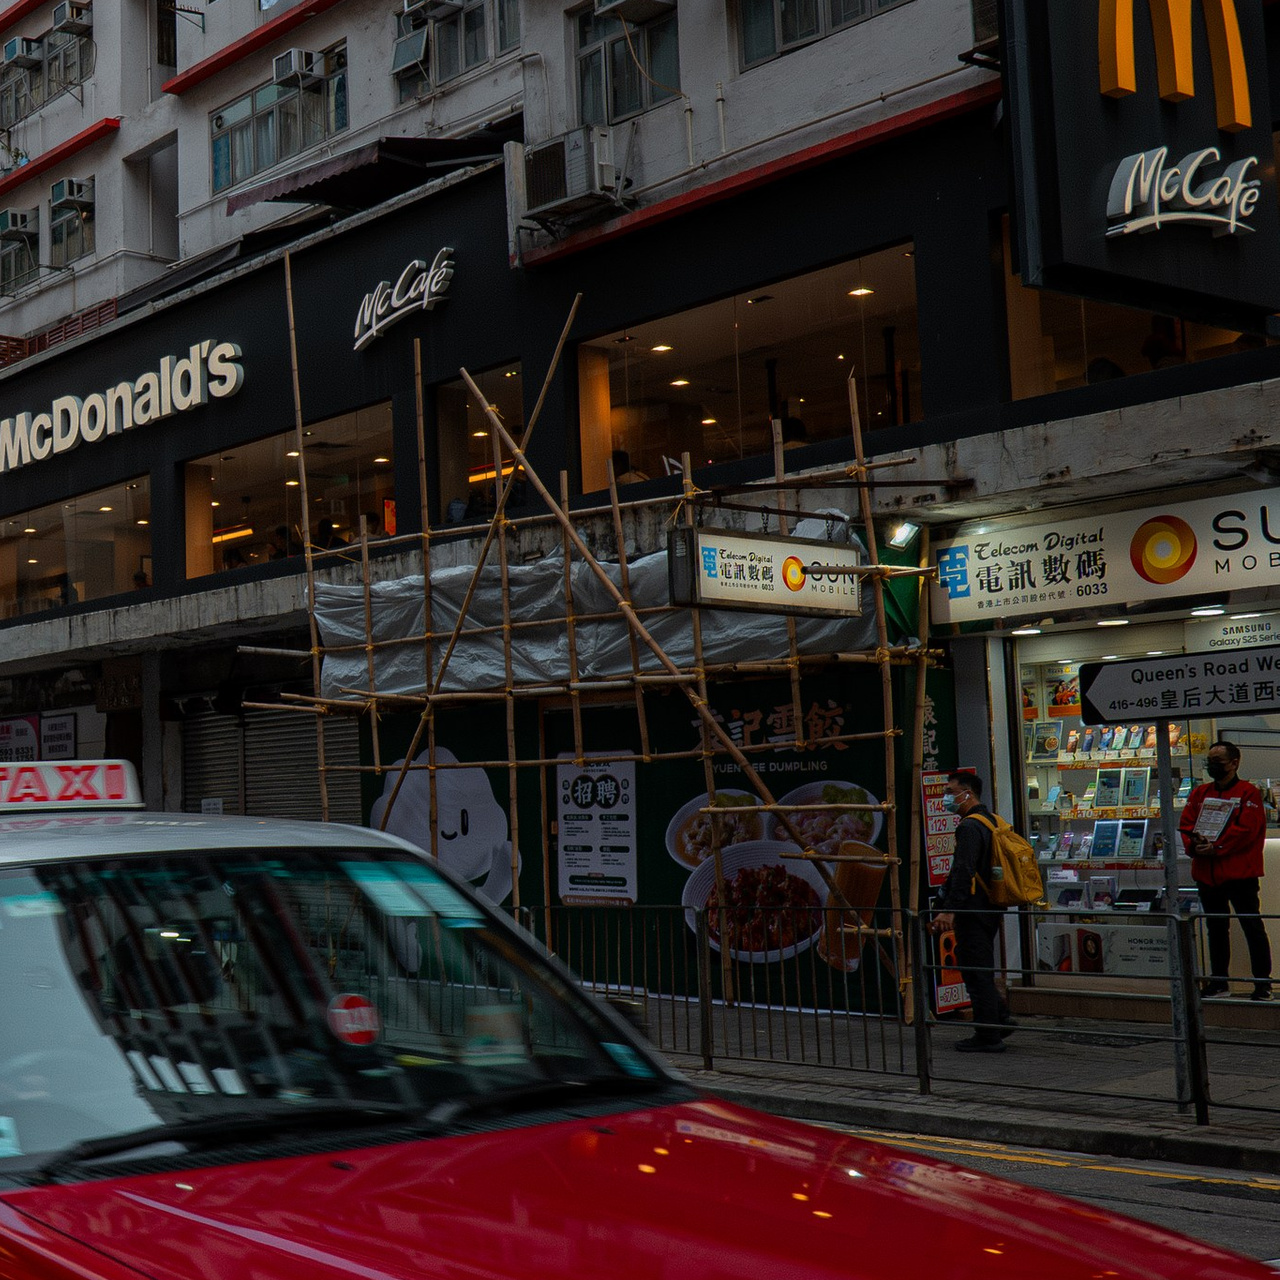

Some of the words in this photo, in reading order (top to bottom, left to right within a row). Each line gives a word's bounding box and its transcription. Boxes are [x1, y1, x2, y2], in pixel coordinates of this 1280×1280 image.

[1106, 146, 1259, 237] McCafé
[354, 247, 455, 351] McCafé
[718, 548, 748, 562] Telecom
[748, 551, 774, 564] Digital
[974, 540, 1039, 562] Telecom
[1043, 527, 1104, 552] Digital
[719, 561, 774, 583] 電訊數碼
[810, 561, 856, 585] SUN
[975, 548, 1108, 594] 電訊數碼
[811, 584, 856, 596] MOBILE
[1076, 582, 1108, 598] 6033
[1222, 622, 1272, 635] SAMSUNG
[1209, 637, 1240, 648] Galaxy
[1242, 634, 1258, 644] S25
[1131, 663, 1197, 684] Queen's
[1204, 658, 1249, 677] Road
[1256, 656, 1280, 672] We
[1109, 696, 1159, 710] 416-496
[1160, 681, 1274, 710] 皇后大道西
[713, 763, 742, 773] YUEN
[769, 761, 828, 772] DUMPLING
[574, 779, 617, 805] 招聘
[1128, 937, 1155, 946] HONOR
